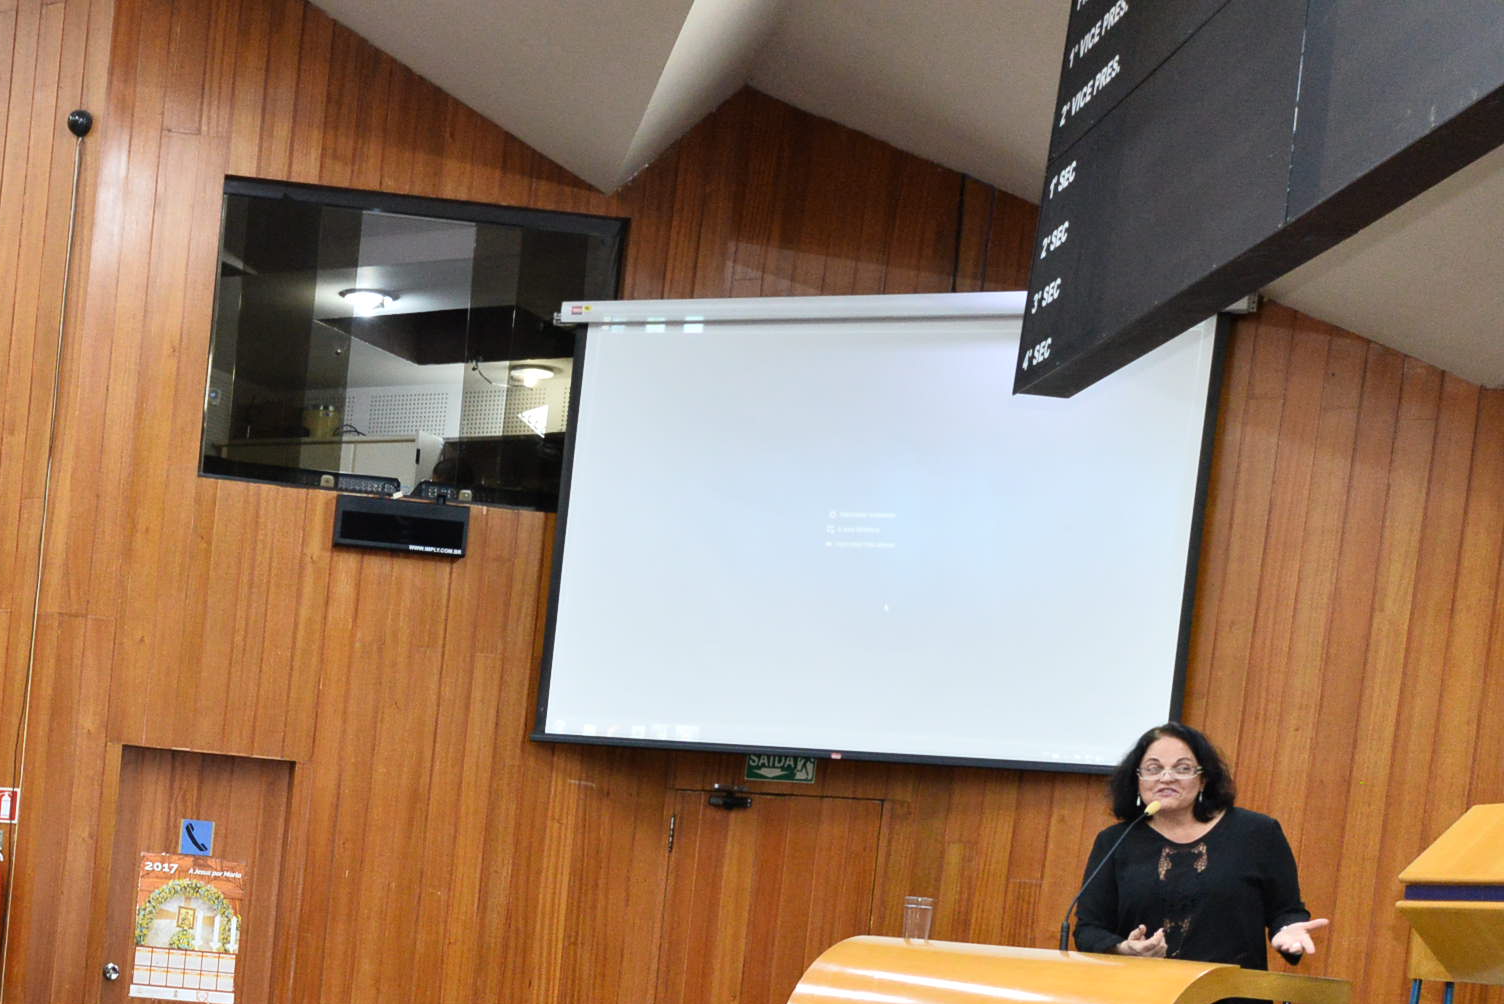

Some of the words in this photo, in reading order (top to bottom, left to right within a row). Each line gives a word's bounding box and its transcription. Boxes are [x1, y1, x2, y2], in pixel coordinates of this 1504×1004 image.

[1079, 20, 1101, 58] VICE
[1071, 79, 1094, 116] VICE
[1058, 160, 1077, 192] SEC
[1050, 220, 1070, 252] SEC
[1041, 277, 1062, 308] SEC
[1032, 337, 1053, 366] SEC
[144, 862, 179, 874] 2017
